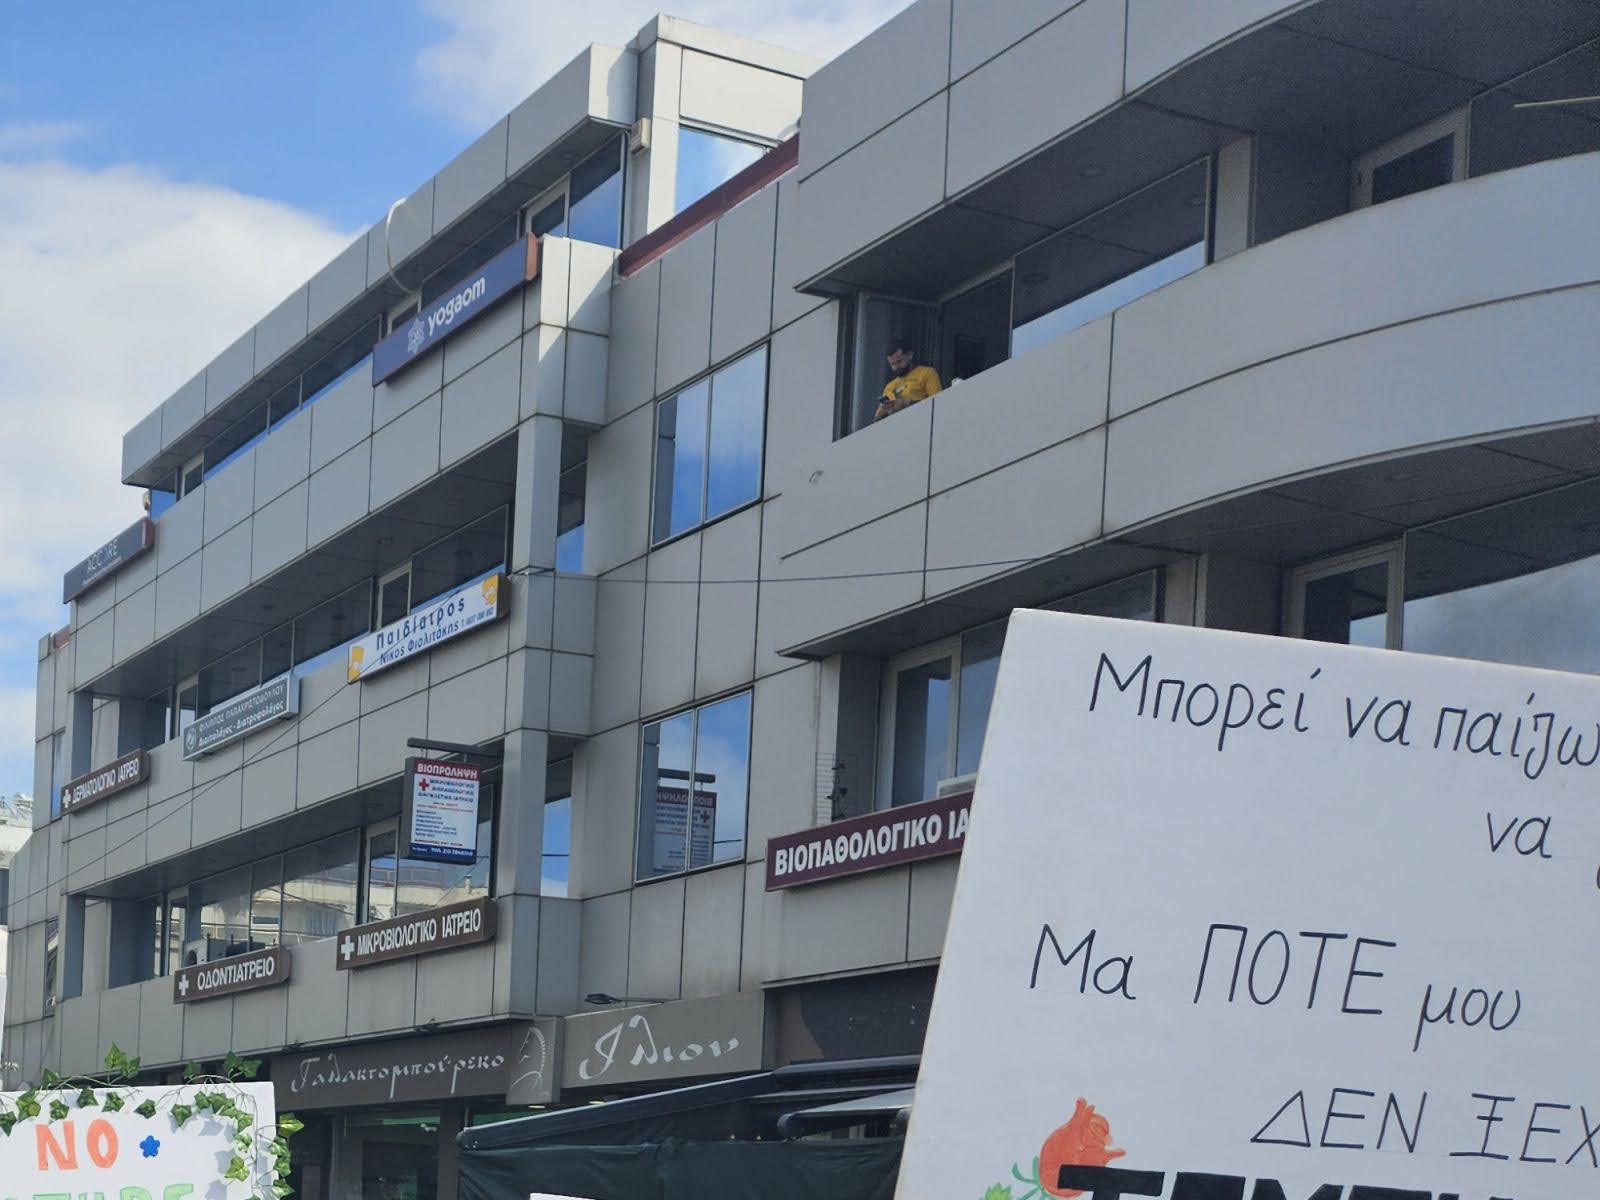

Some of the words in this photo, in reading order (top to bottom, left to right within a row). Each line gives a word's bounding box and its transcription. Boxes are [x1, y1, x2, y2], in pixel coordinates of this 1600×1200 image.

[428, 276, 486, 336] yogaom
[1088, 652, 1322, 752] Μπορεί
[1345, 696, 1411, 746] να
[72, 769, 116, 803] ΔΕΡΜΑΤΟΛΟΓΙΚΟ
[117, 758, 140, 786] ΙΑΤΡΕΙΟ
[417, 764, 477, 779] ΒΙΟΠΡΟΛΗΨΗ
[774, 817, 942, 876] ΒΙΟΠΑΘΟΛΟΓΙΚΟ
[1486, 811, 1553, 859] να
[357, 918, 437, 957] ΜΙΚΡΟΒΙΟΛΟΓΙΚΟ
[441, 907, 481, 938] ΙΑΤΡΕΙΟ
[197, 956, 275, 991] ΟΔΟΝΤΙΑΤΡΕΙΟ
[1030, 923, 1136, 1000] Μα
[1193, 923, 1397, 1015] ΠΟΤΕ
[1412, 984, 1522, 1052] μου
[35, 1118, 119, 1171] NO
[1250, 1087, 1428, 1154] ΔΕΝ
